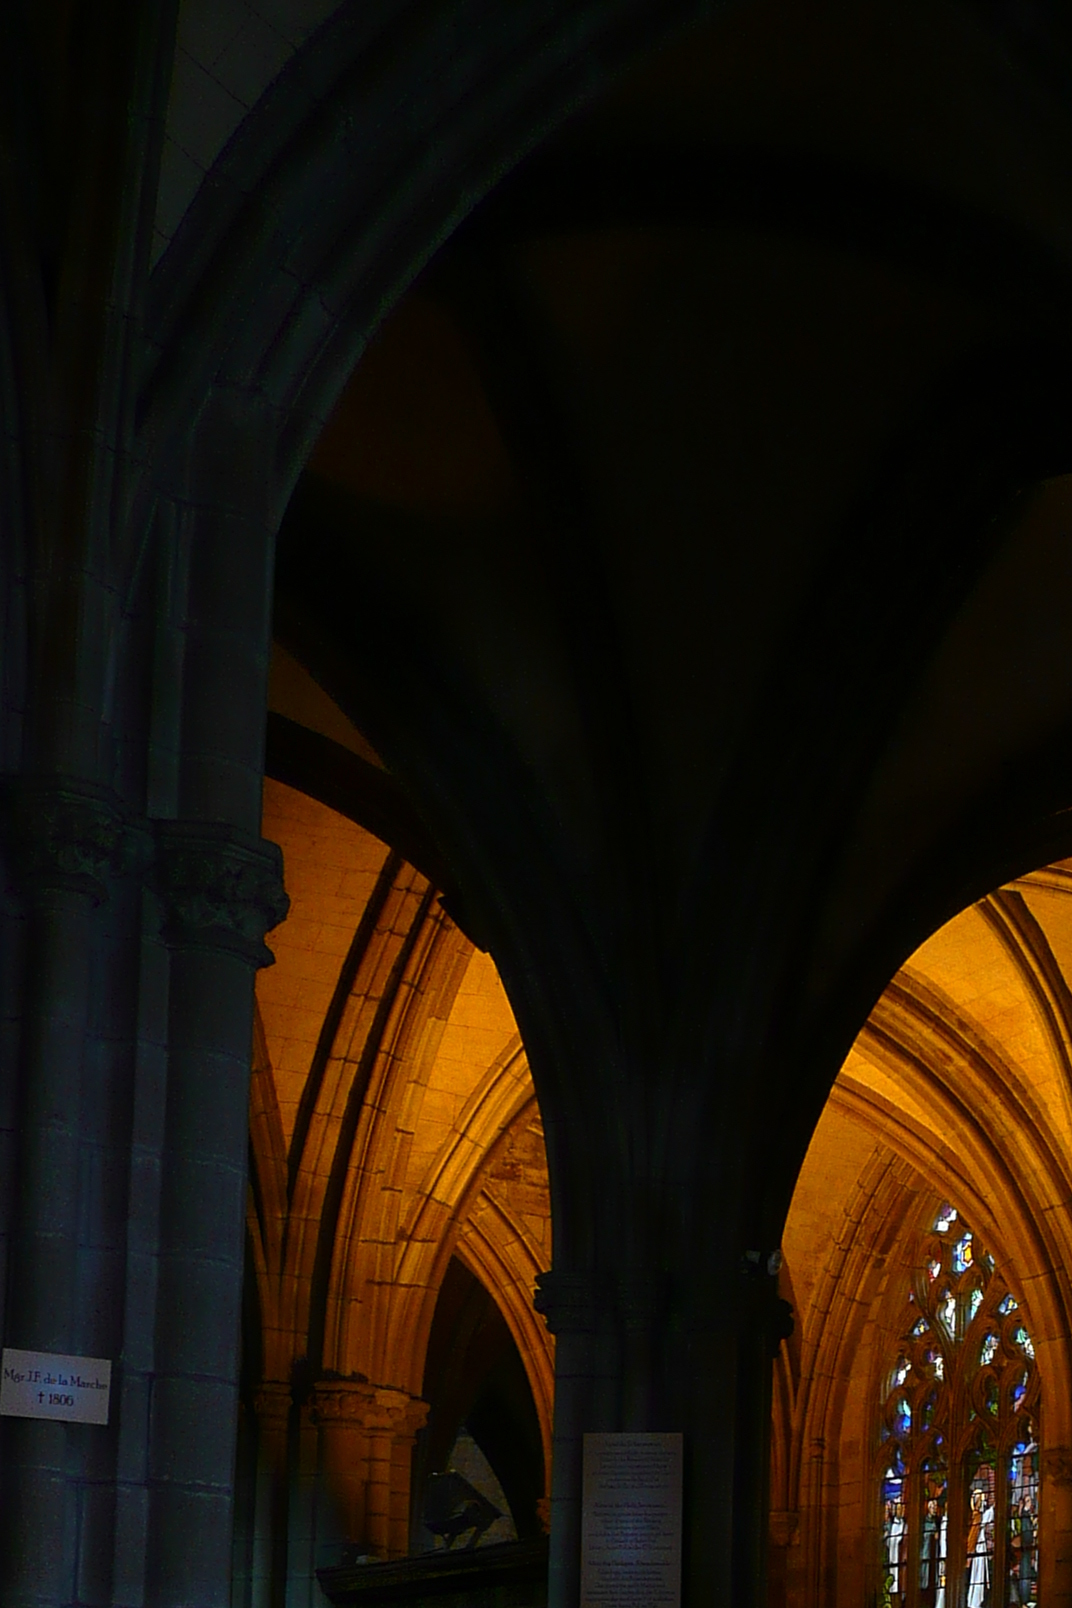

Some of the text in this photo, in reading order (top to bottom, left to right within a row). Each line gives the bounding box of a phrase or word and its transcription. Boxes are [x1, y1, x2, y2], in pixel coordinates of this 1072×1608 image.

[44, 1372, 57, 1385] de
[59, 1374, 68, 1386] la
[70, 1375, 108, 1390] Marche
